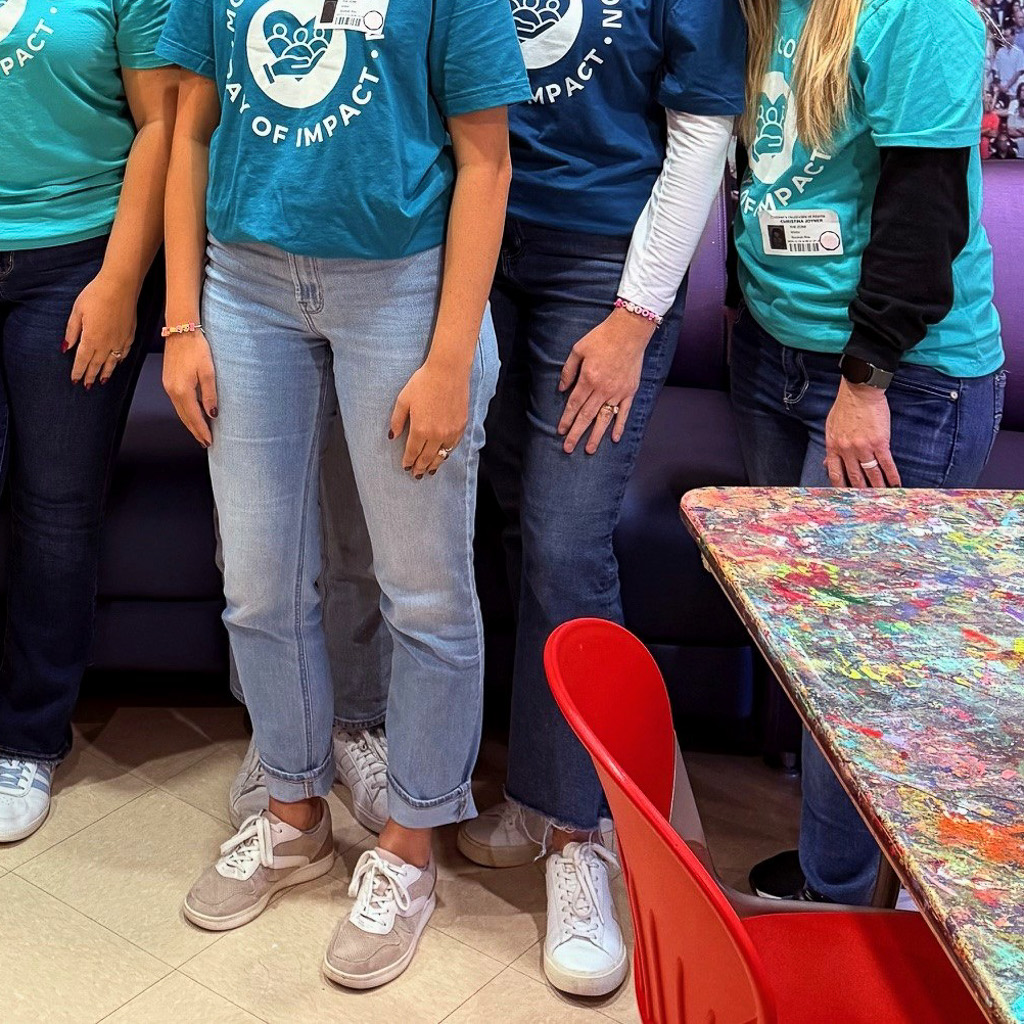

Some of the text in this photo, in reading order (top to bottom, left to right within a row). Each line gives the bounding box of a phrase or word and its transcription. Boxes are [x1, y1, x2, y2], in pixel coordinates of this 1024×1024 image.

[251, 115, 288, 144] OF
[295, 66, 380, 147] IMPACT
[527, 48, 604, 105] MPACT
